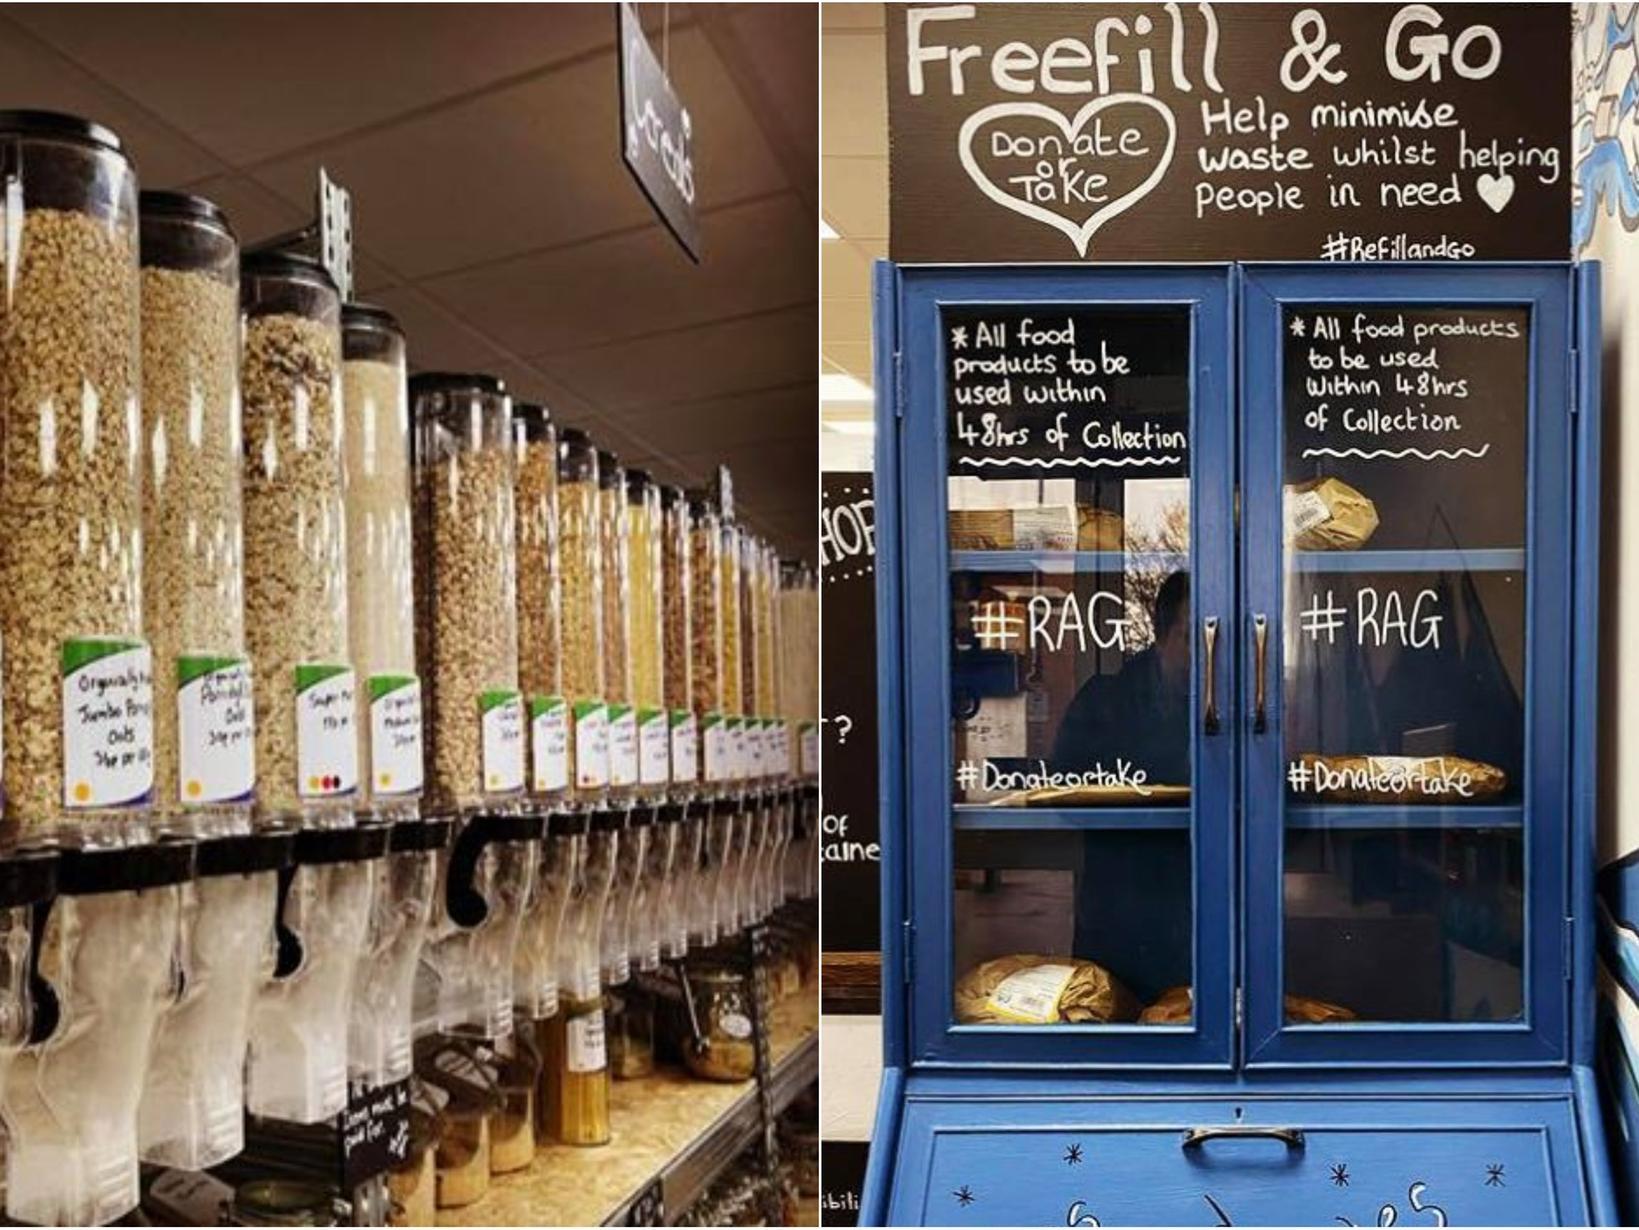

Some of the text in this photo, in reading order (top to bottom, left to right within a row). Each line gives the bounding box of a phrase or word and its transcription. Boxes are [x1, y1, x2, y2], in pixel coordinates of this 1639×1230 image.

[907, 2, 1502, 96] Freefill & Go
[1201, 95, 1458, 141] Help minimise
[991, 118, 1150, 156] Donate
[1035, 157, 1078, 179] or
[1198, 128, 1560, 184] waste whilst helping
[1008, 169, 1109, 204] Take
[1195, 172, 1462, 218] people in need
[1017, 318, 1075, 347] food
[1351, 312, 1404, 344] food
[1413, 317, 1520, 345] products
[954, 340, 1131, 380] products to be
[1308, 345, 1439, 370] to be used
[955, 376, 1107, 405] used within
[1396, 371, 1469, 398] 48hrs
[956, 411, 1187, 451] 48hrs of Collection
[1304, 402, 1462, 435] of Collection
[970, 591, 1132, 651] #RAG
